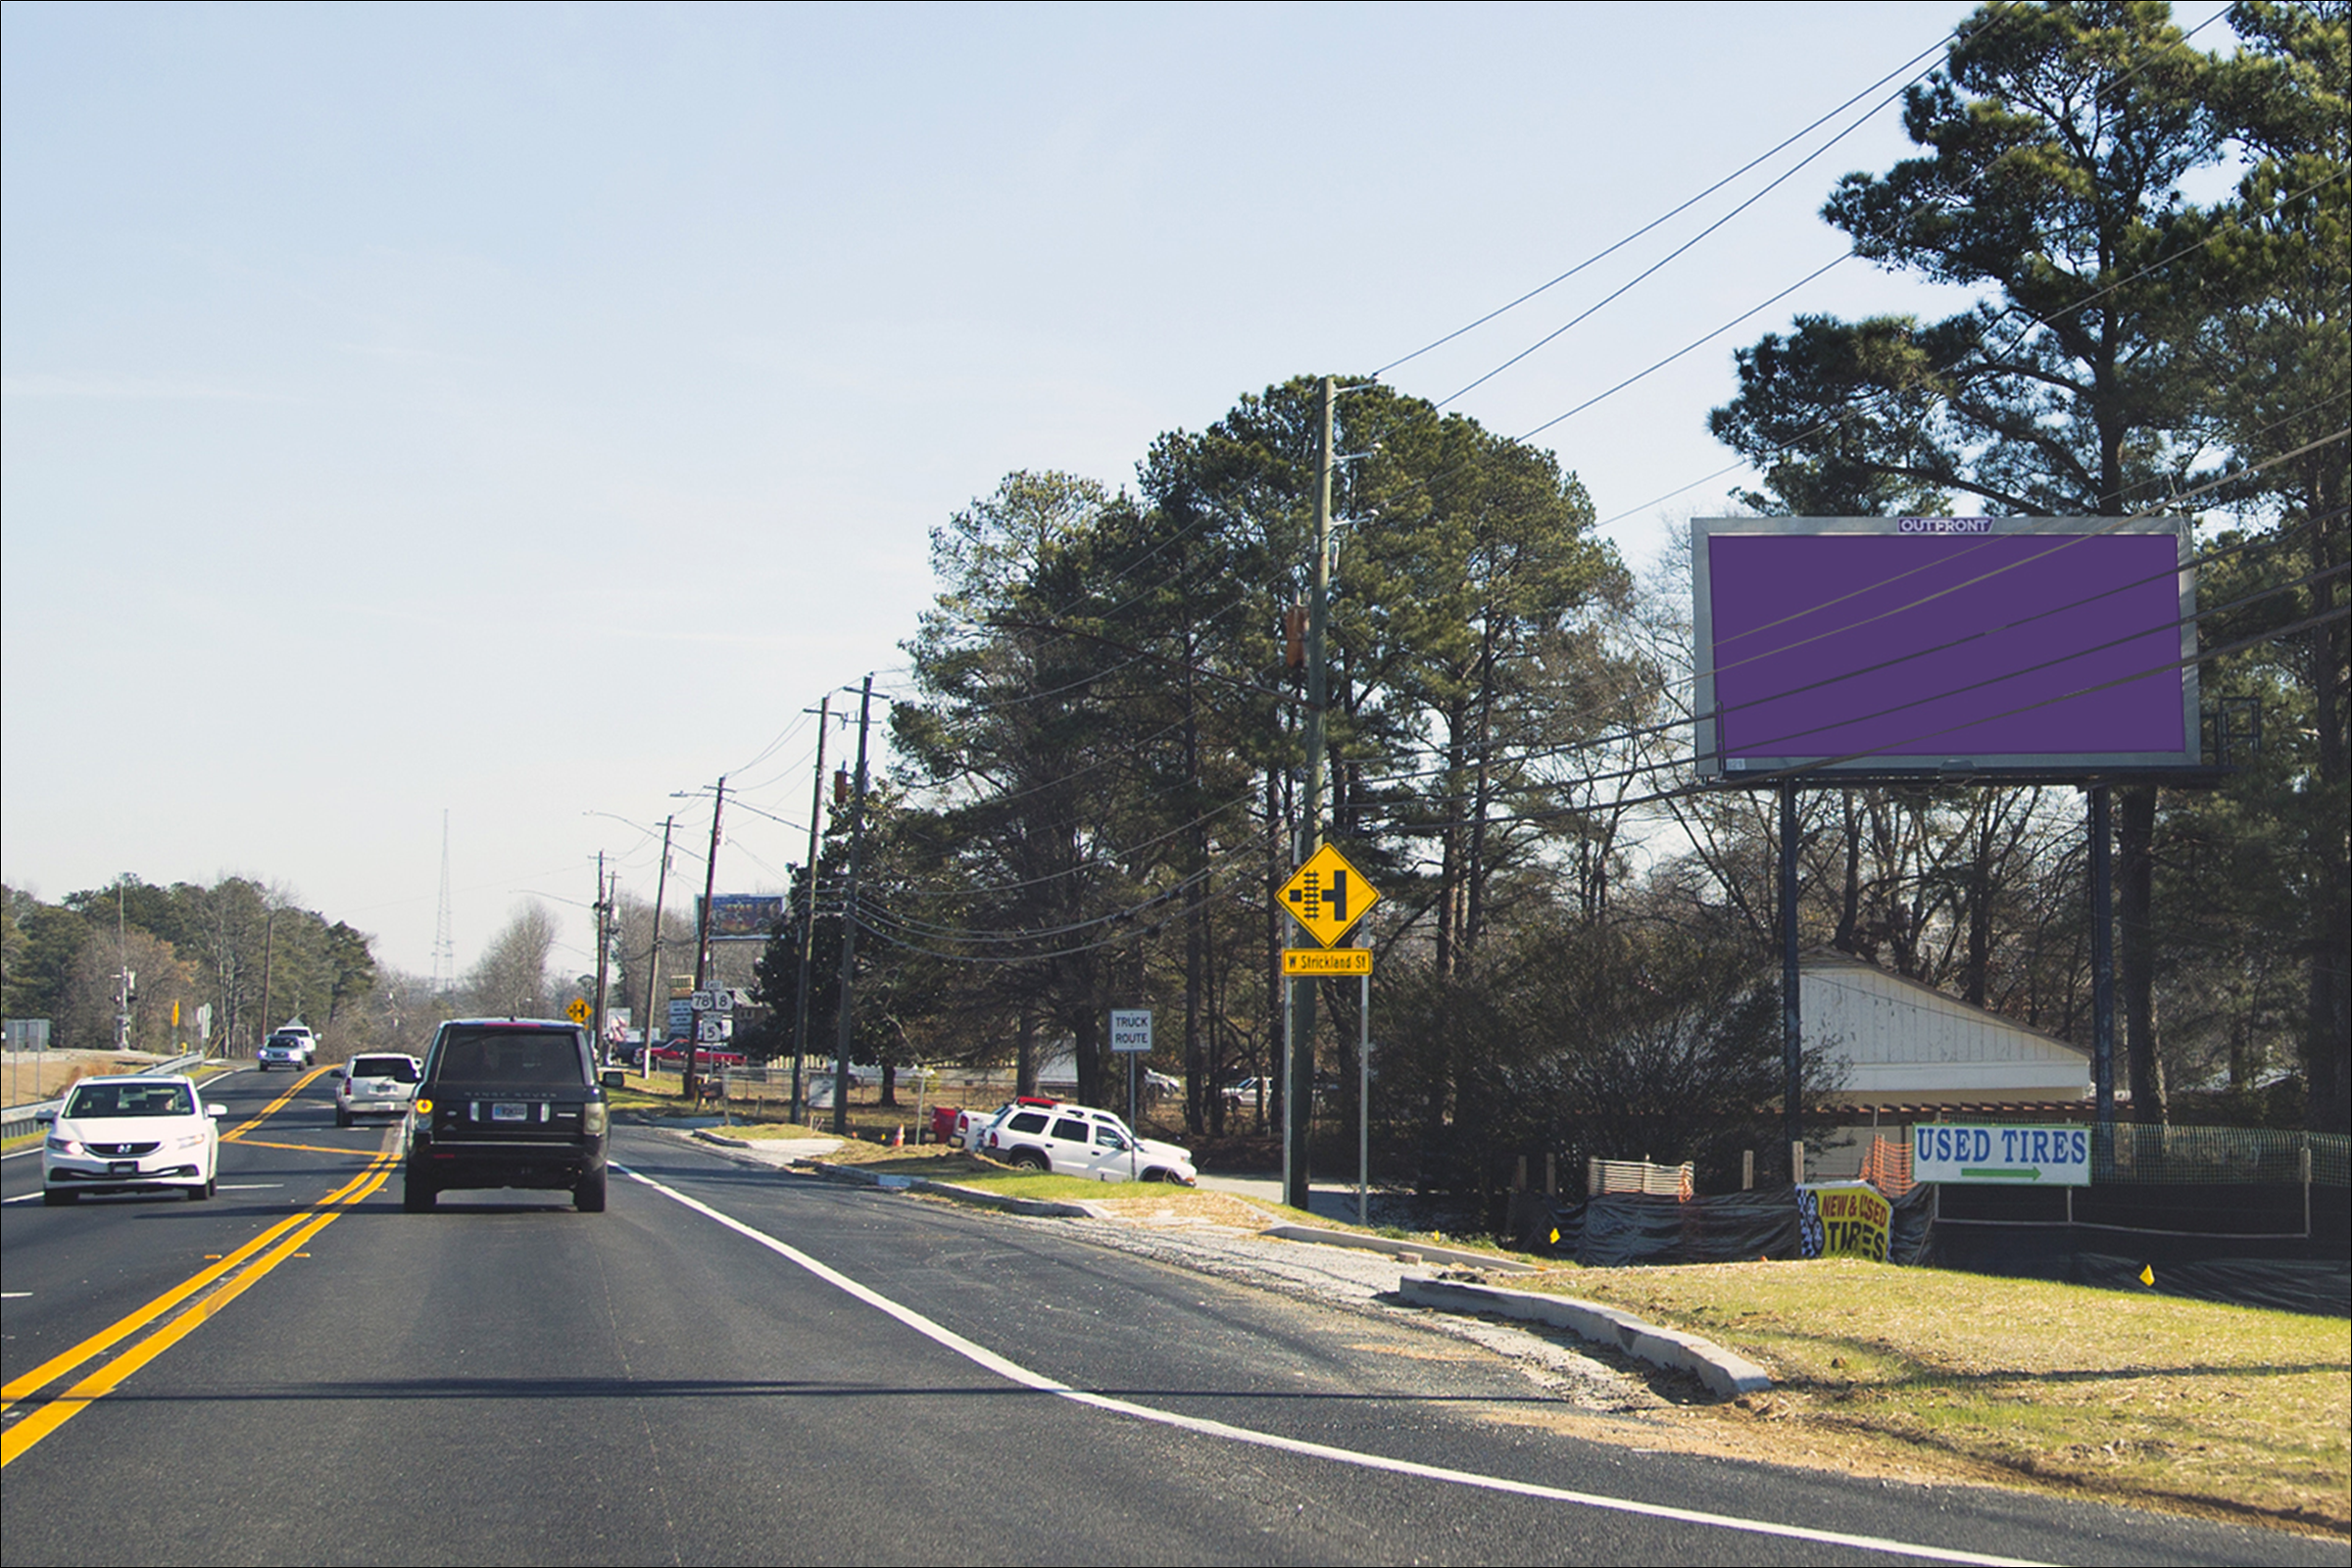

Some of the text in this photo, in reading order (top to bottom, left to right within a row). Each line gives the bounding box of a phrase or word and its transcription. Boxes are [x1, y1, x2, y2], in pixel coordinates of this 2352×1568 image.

[1901, 519, 1988, 531] OUTFRONT
[1288, 955, 1366, 969] W Strickland St
[693, 995, 710, 1006] 78
[719, 995, 727, 1006] 8
[1115, 1016, 1149, 1027] TRUCK
[708, 1026, 715, 1038] 5
[1115, 1033, 1149, 1044] ROUTE
[1917, 1128, 2086, 1164] USED TIRES
[1822, 1195, 1887, 1229] NEW & USED
[1828, 1221, 1886, 1262] TIRES
